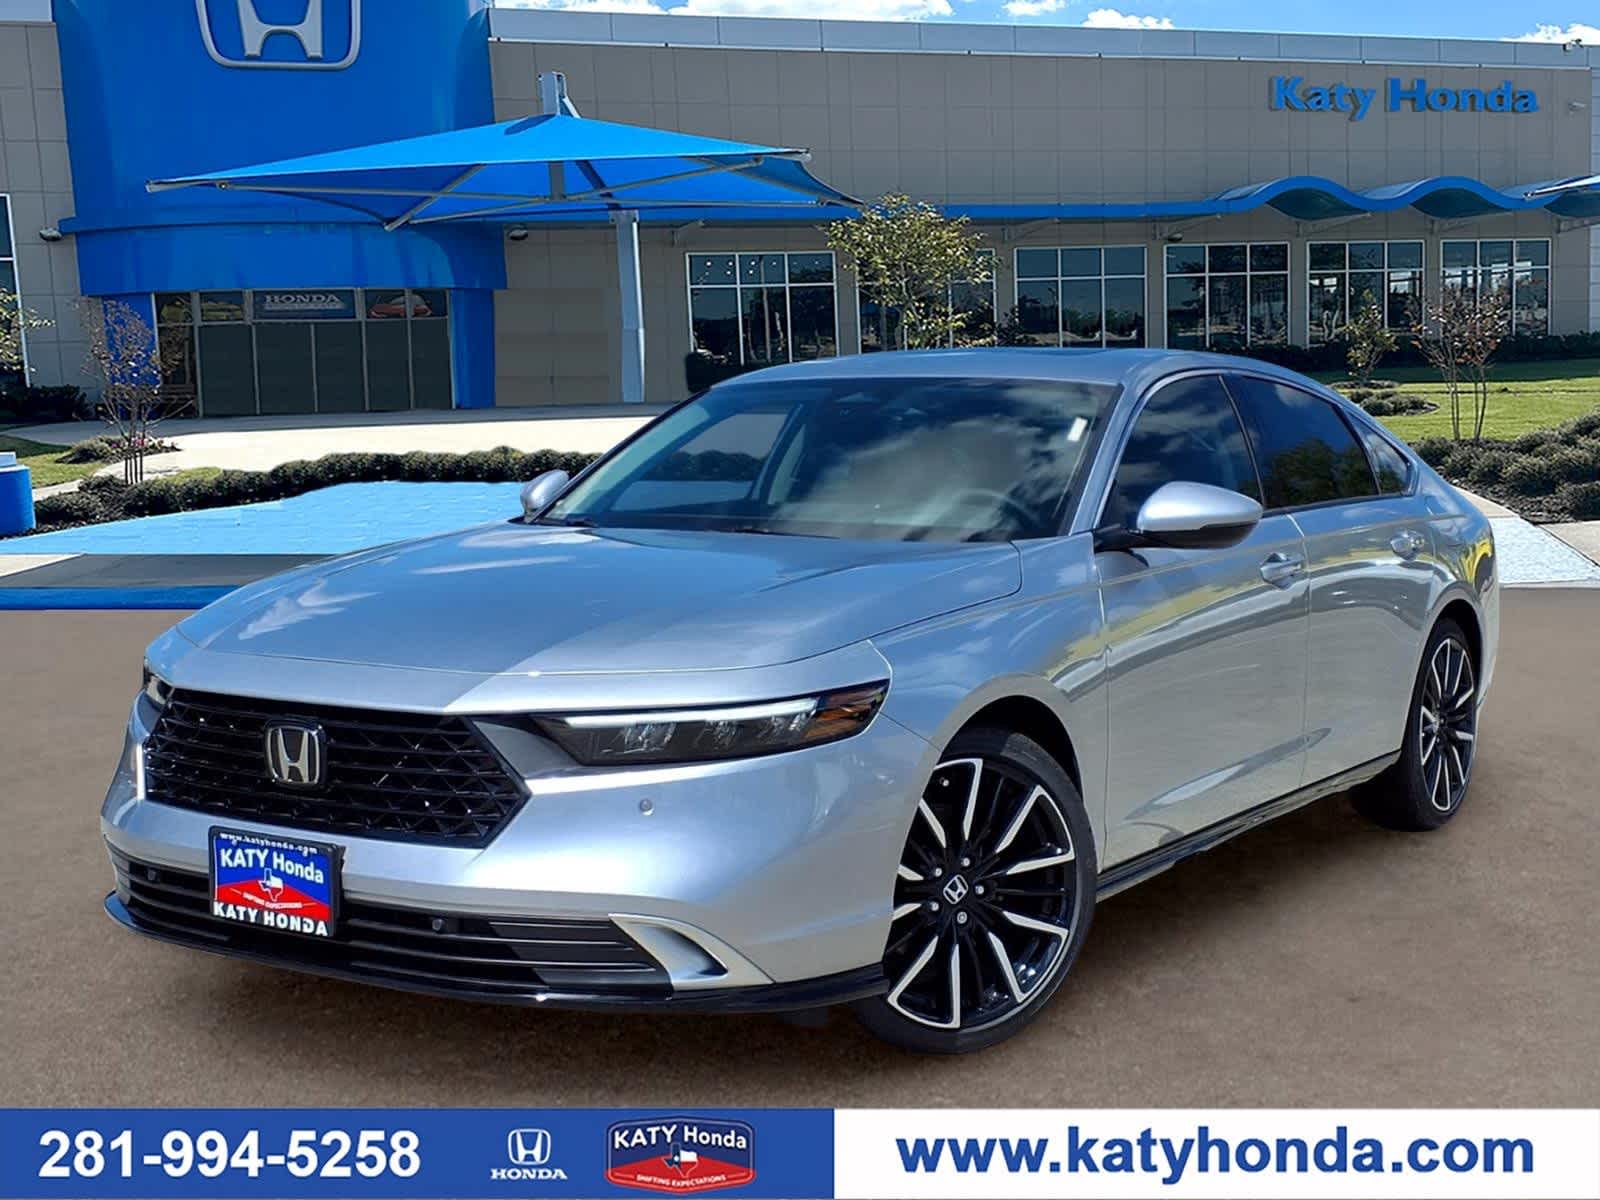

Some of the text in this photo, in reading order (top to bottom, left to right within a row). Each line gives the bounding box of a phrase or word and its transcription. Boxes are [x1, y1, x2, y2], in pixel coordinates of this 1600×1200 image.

[1269, 75, 1539, 121] Katy Honda
[263, 294, 342, 304] HONDA
[220, 848, 324, 884] KATY Honda
[213, 901, 328, 936] KATY HONDA
